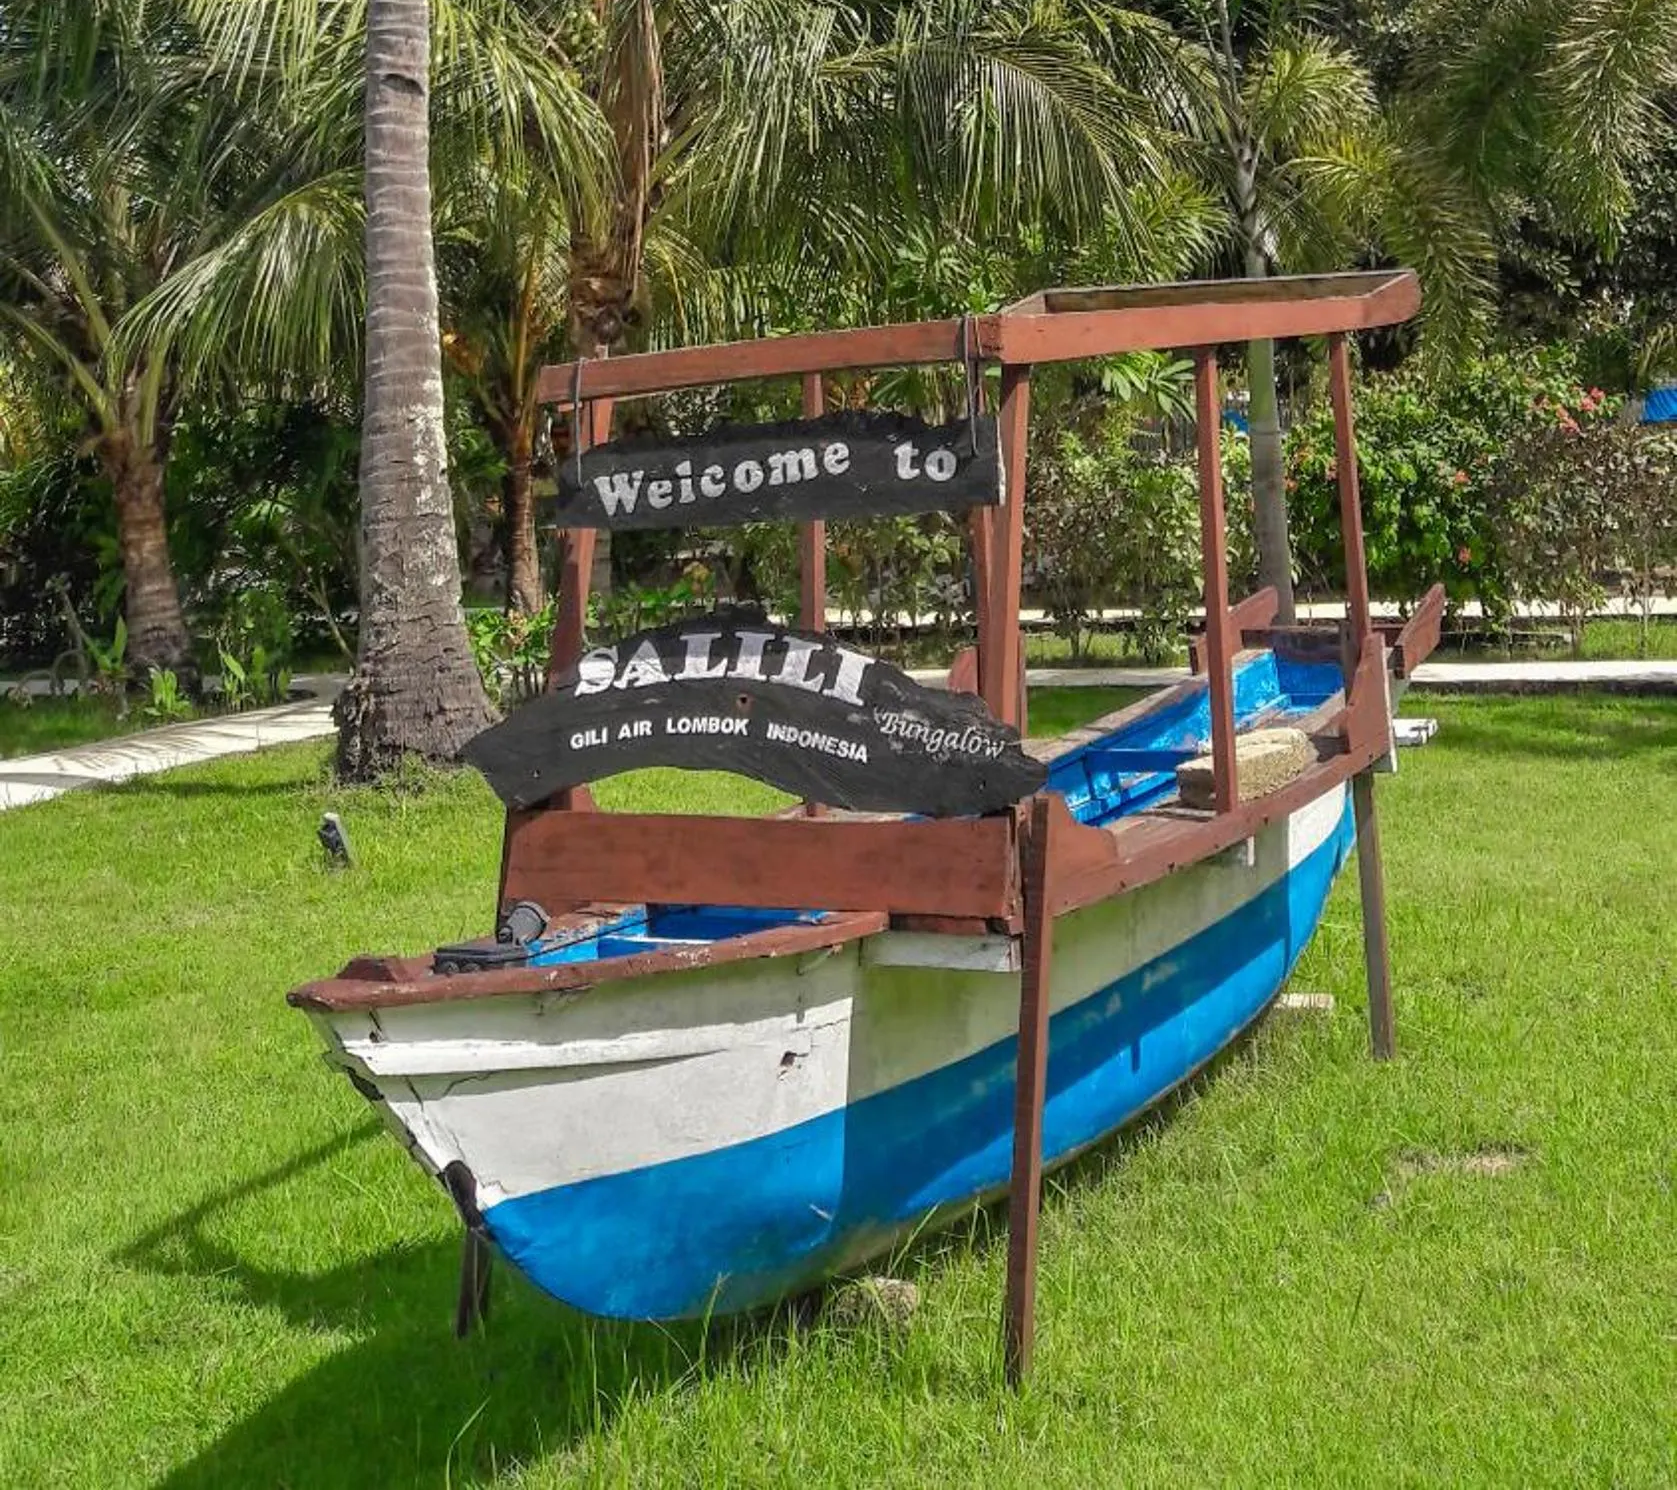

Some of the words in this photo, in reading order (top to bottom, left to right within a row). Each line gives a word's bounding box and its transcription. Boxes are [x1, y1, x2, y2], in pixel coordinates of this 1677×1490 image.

[593, 441, 851, 516] Welcome
[893, 440, 957, 481] to
[573, 631, 876, 706] SALILI
[569, 729, 608, 751] GILI
[618, 720, 653, 740] AIR
[665, 716, 749, 737] LOMBOK
[766, 722, 869, 764] INDONESIA
[874, 707, 1005, 758] Bungalow
